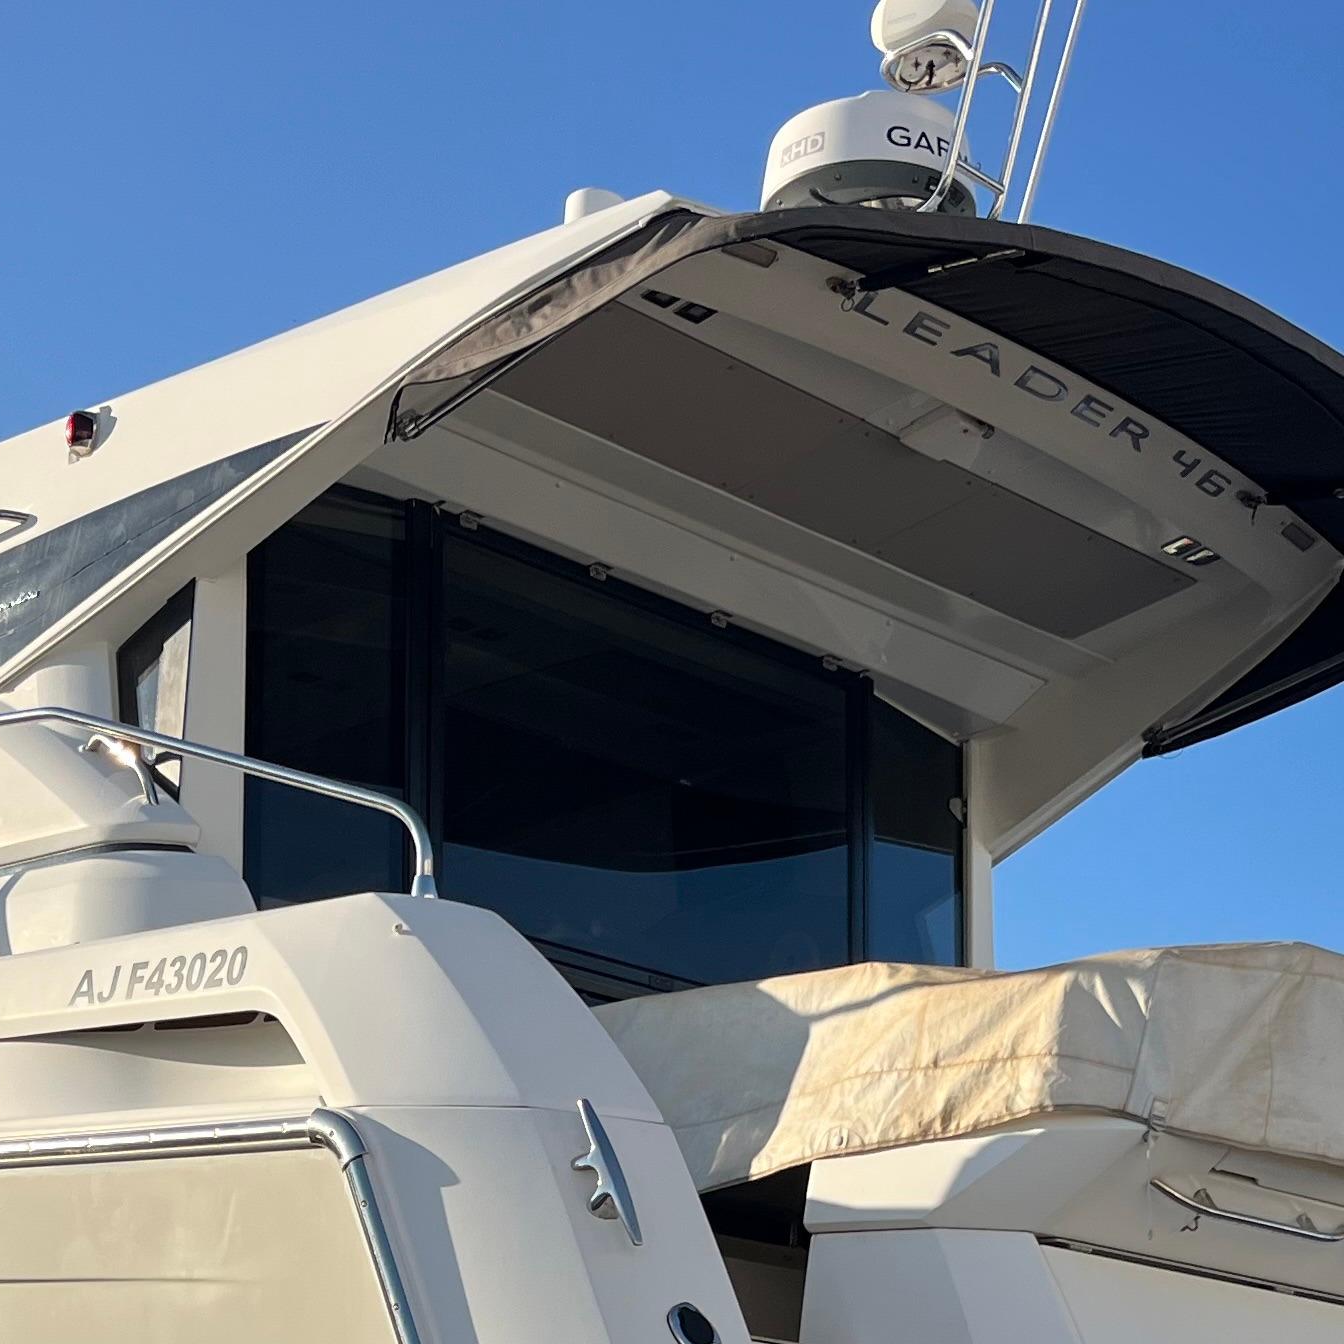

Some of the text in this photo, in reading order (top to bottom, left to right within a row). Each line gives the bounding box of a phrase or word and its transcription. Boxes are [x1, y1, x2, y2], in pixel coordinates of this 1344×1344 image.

[853, 291, 1232, 498] LEADER 46
[125, 945, 248, 1000] F43020
